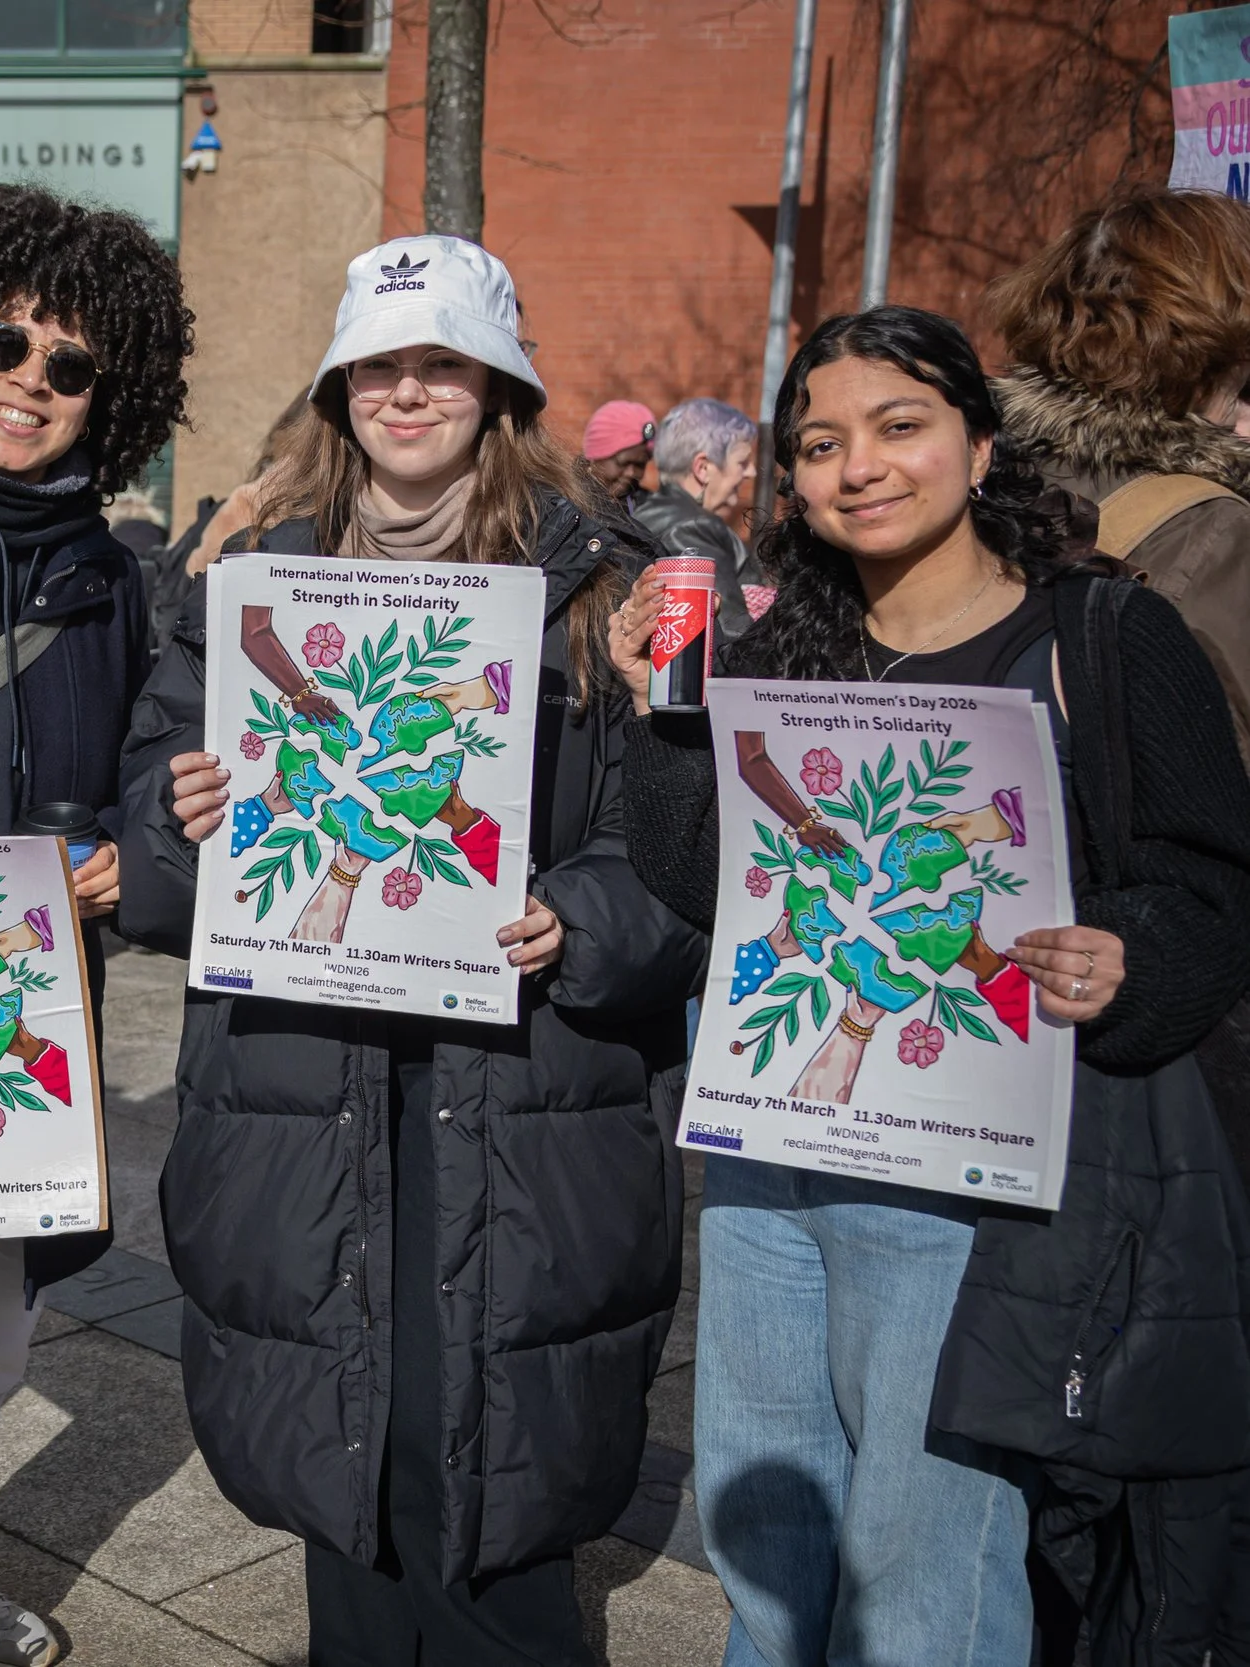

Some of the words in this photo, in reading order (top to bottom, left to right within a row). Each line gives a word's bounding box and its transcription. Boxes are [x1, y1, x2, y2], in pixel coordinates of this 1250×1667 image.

[375, 280, 425, 294] adidas
[270, 566, 353, 582] International
[424, 574, 450, 589] Day
[453, 575, 488, 588] 2026
[292, 589, 359, 607] Strength
[364, 593, 377, 606] in
[382, 594, 459, 613] Solidarity
[754, 690, 838, 704] International
[909, 696, 936, 711] Day
[939, 697, 977, 710] 2026
[781, 713, 850, 731] Strength
[854, 716, 869, 729] in
[873, 717, 952, 737] Solidarity
[211, 934, 266, 951] Saturday
[269, 940, 288, 951] 7th
[292, 942, 331, 955] March
[346, 948, 400, 963] 11.30am
[404, 954, 450, 969] Writers
[454, 960, 500, 974] Square
[325, 964, 369, 976] IWDNI26
[204, 974, 252, 990] AGENDA
[287, 975, 406, 996] reclaimtheagenda.com
[464, 1005, 476, 1013] City
[476, 1006, 499, 1015] Council
[465, 998, 487, 1006] Belfast
[697, 1087, 761, 1109] Saturday
[765, 1097, 786, 1110] 7th
[791, 1101, 835, 1117] March
[854, 1110, 916, 1129] 11.30am
[921, 1119, 976, 1138] Writers
[980, 1128, 1034, 1146] Square
[686, 1131, 743, 1151] AGENDA
[827, 1127, 879, 1143] IWDNI26
[783, 1137, 922, 1168] reclaimtheagenda.com
[991, 1172, 1019, 1183] Belfast
[0, 1183, 42, 1193] Writers
[46, 1181, 87, 1192] Square
[990, 1180, 1005, 1190] City
[1005, 1182, 1033, 1194] Council
[59, 1219, 70, 1228] City
[70, 1219, 91, 1227] Council
